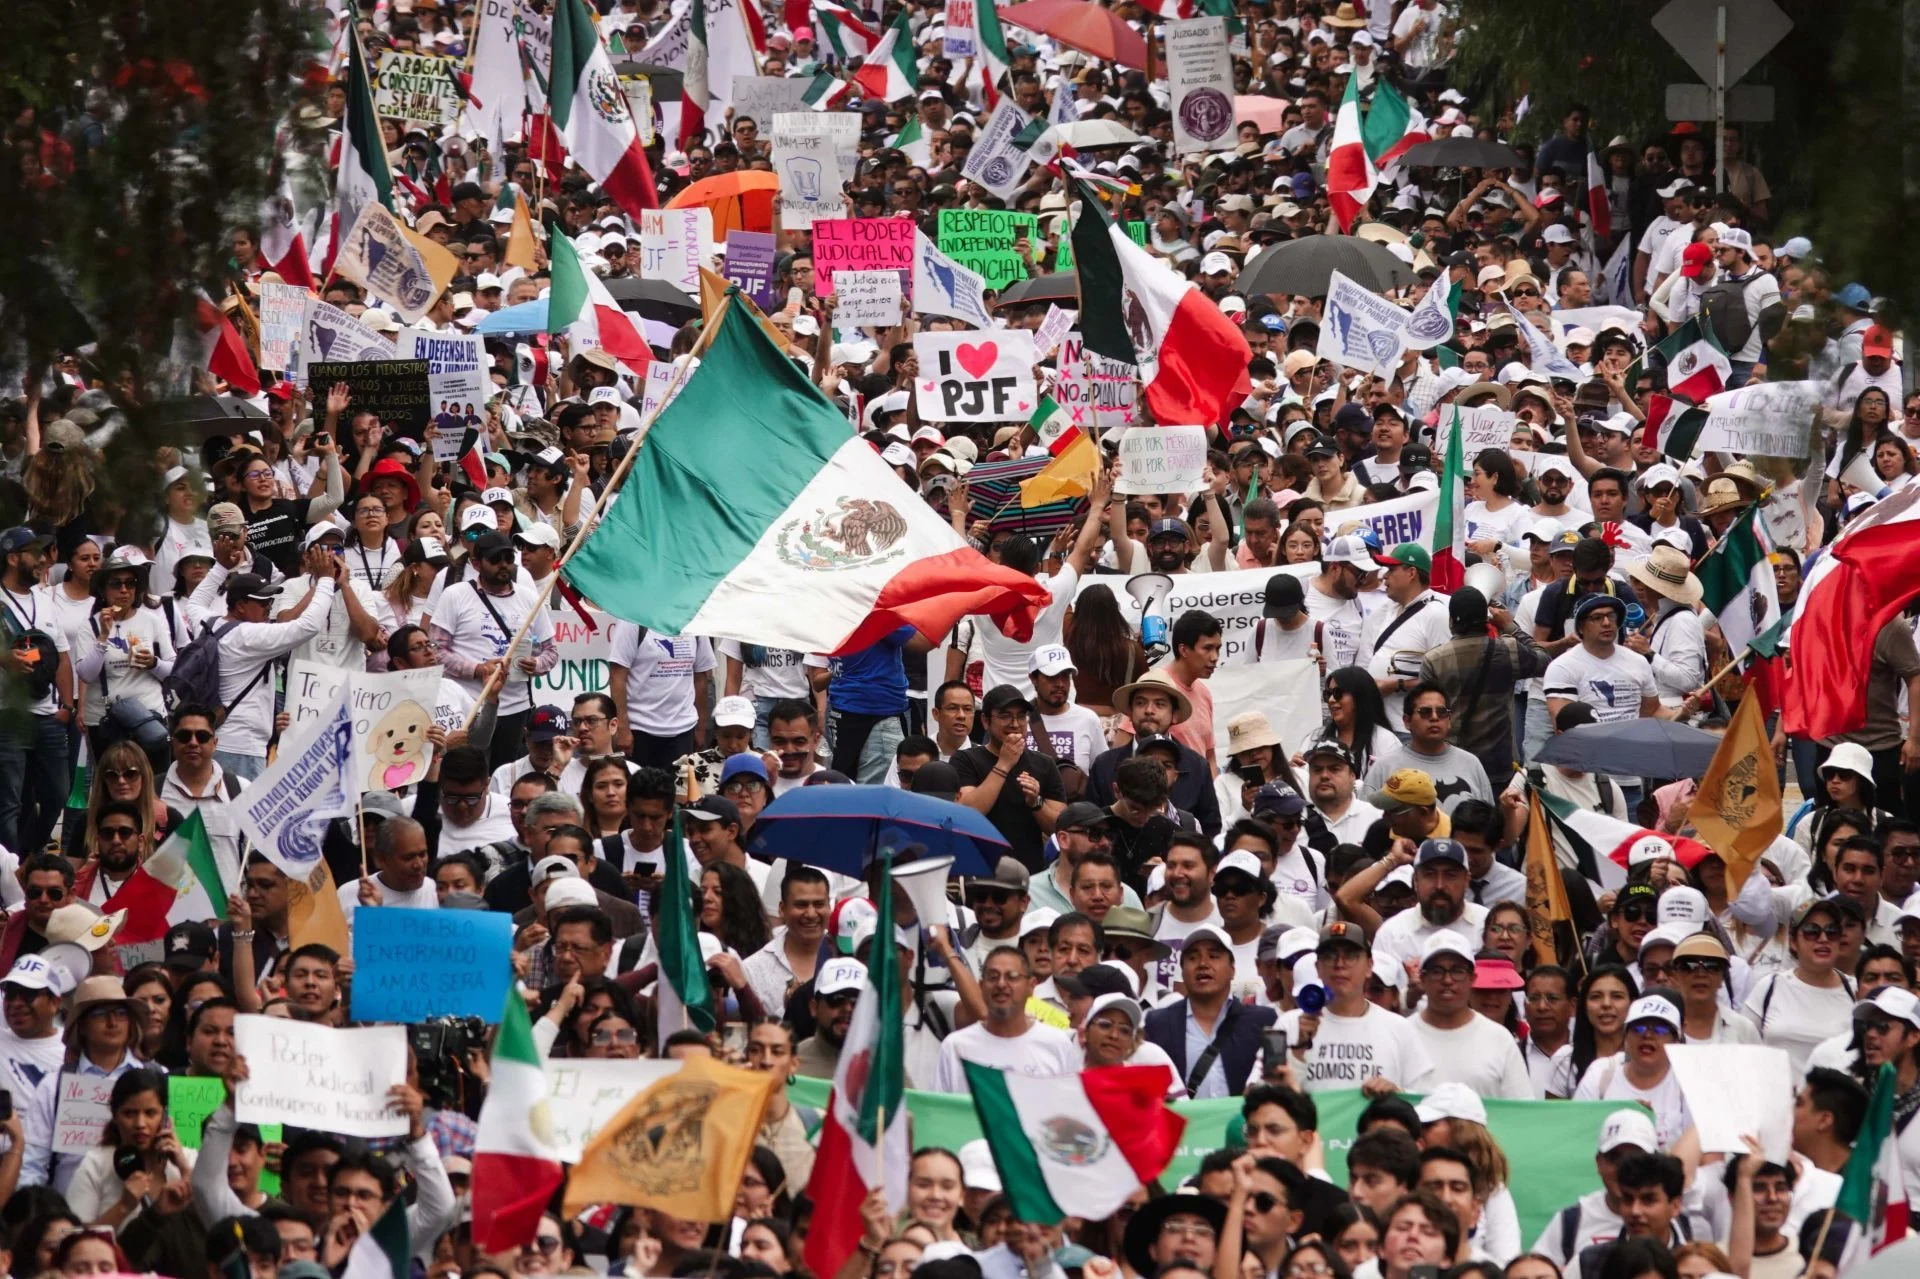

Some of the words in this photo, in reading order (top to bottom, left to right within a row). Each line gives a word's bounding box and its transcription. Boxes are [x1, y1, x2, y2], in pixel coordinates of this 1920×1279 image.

[816, 222, 843, 241] EL
[852, 221, 914, 242] PODER
[943, 211, 1004, 235] RESPETO
[816, 244, 886, 261] JUDICIAL
[890, 245, 914, 263] NO
[940, 238, 1013, 252] INDEPENDEN
[415, 336, 427, 359] EN
[429, 340, 465, 363] DEFENSA
[466, 341, 478, 363] DEL
[352, 364, 369, 376] LOS
[941, 376, 1017, 416] PJF
[1057, 383, 1080, 403] NO
[488, 491, 507, 501] PJF
[469, 510, 489, 519] PJF
[1170, 591, 1266, 612] poderes
[298, 671, 321, 700] Te
[1644, 846, 1663, 855] PJF
[836, 968, 860, 981] PJF
[1641, 1002, 1671, 1014] PJF
[270, 1032, 330, 1067] Poder
[1319, 1043, 1373, 1061] #TODOS
[1306, 1062, 1355, 1081] SOMOS
[67, 1081, 83, 1099] No
